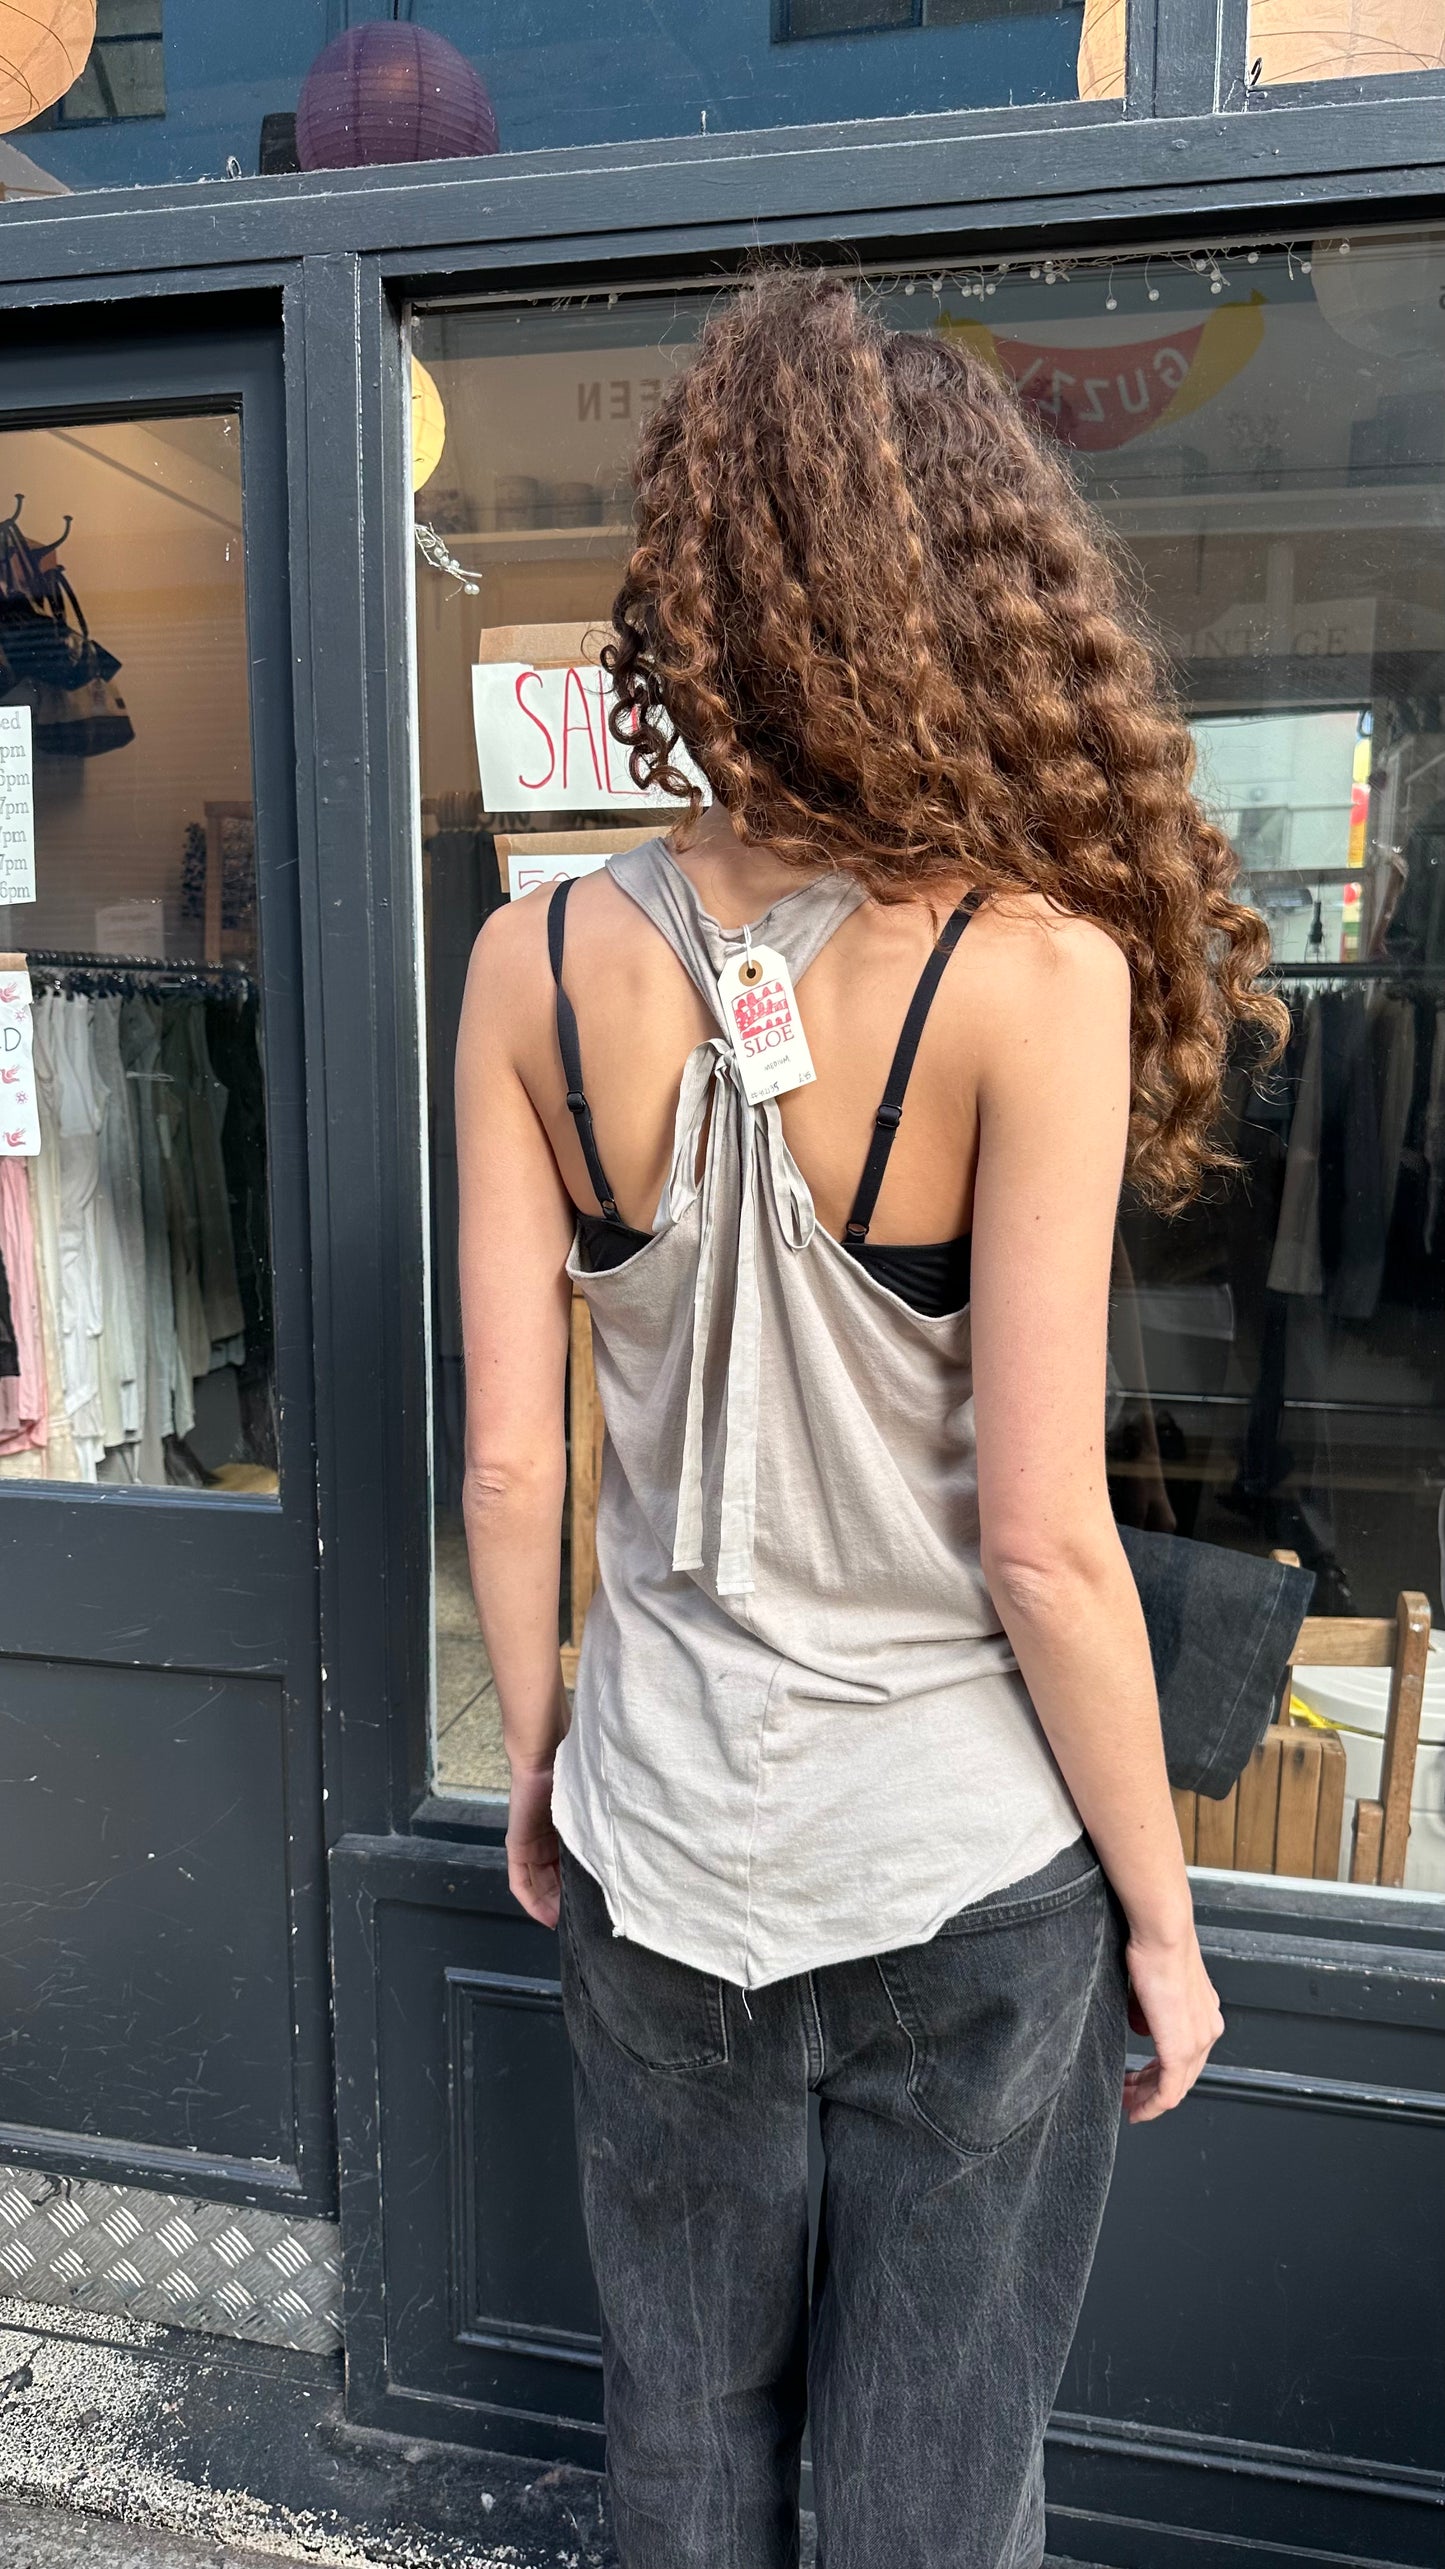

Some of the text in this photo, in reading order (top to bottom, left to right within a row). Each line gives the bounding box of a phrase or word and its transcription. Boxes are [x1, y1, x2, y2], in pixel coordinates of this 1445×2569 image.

[0, 710, 21, 730] ed
[0, 826, 27, 848] pm
[744, 1024, 795, 1058] SLOE
